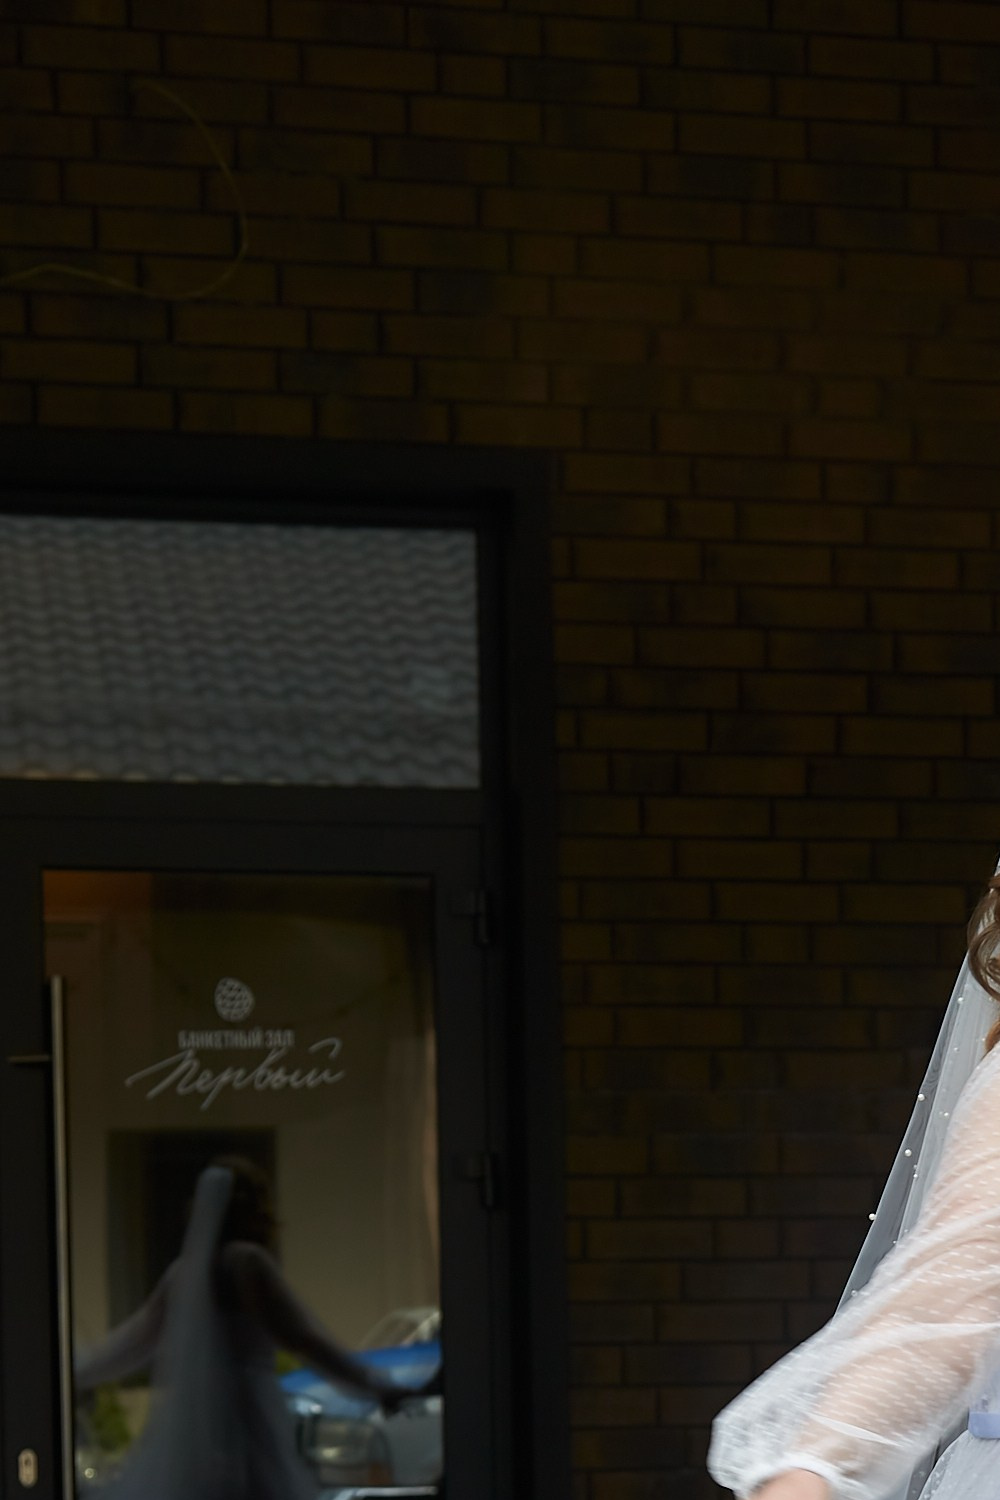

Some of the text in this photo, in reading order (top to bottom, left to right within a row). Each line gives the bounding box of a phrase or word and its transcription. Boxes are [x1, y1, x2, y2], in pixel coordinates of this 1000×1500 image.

[178, 1028, 294, 1048] БАНКЕТНЫЙ ЗАЛ
[124, 1038, 346, 1110] Первый
